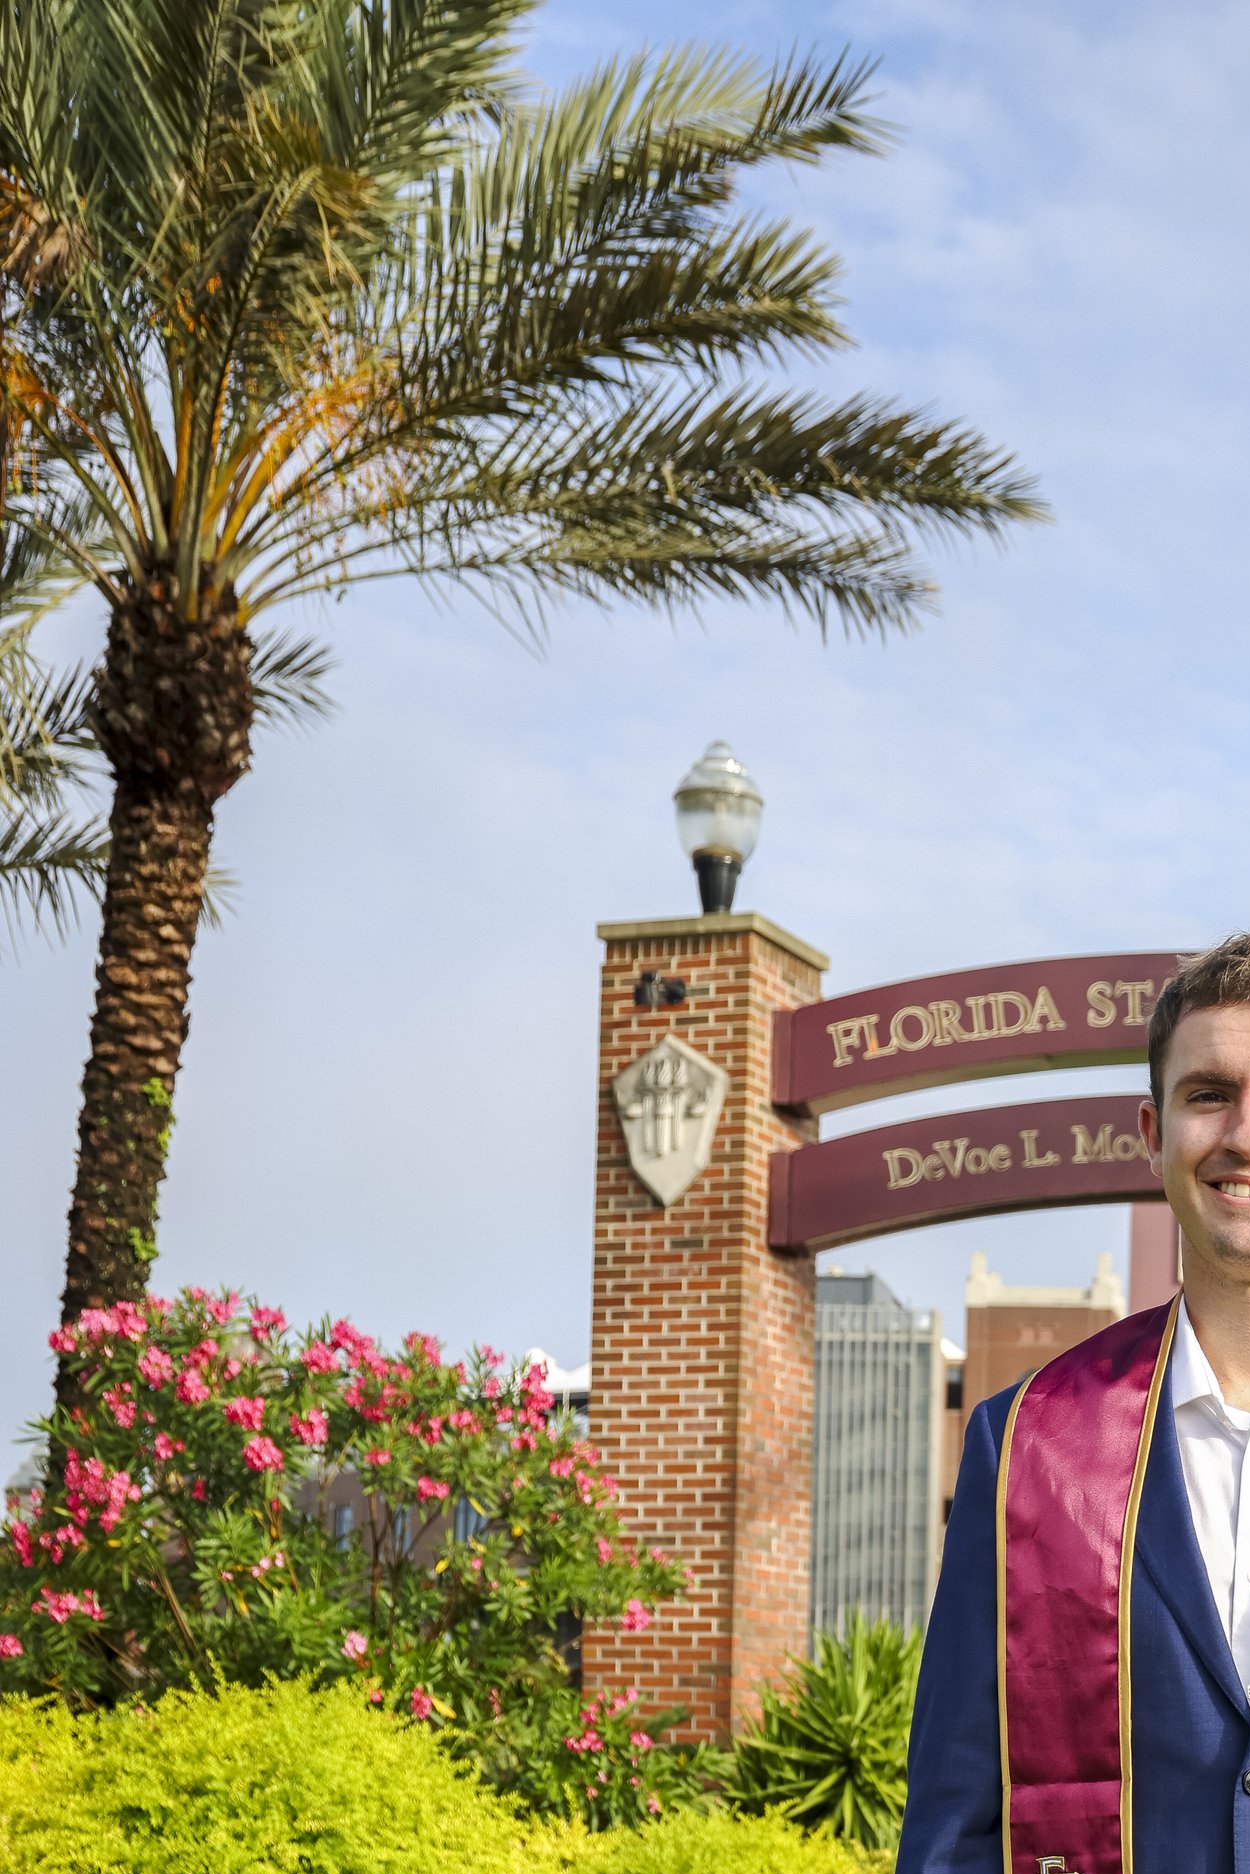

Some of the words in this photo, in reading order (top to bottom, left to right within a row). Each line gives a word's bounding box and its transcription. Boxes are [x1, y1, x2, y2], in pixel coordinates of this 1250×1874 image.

[826, 985, 1067, 1068] FLORIDA
[882, 1137, 1012, 1190] DeVoe
[1019, 1129, 1061, 1168] L.
